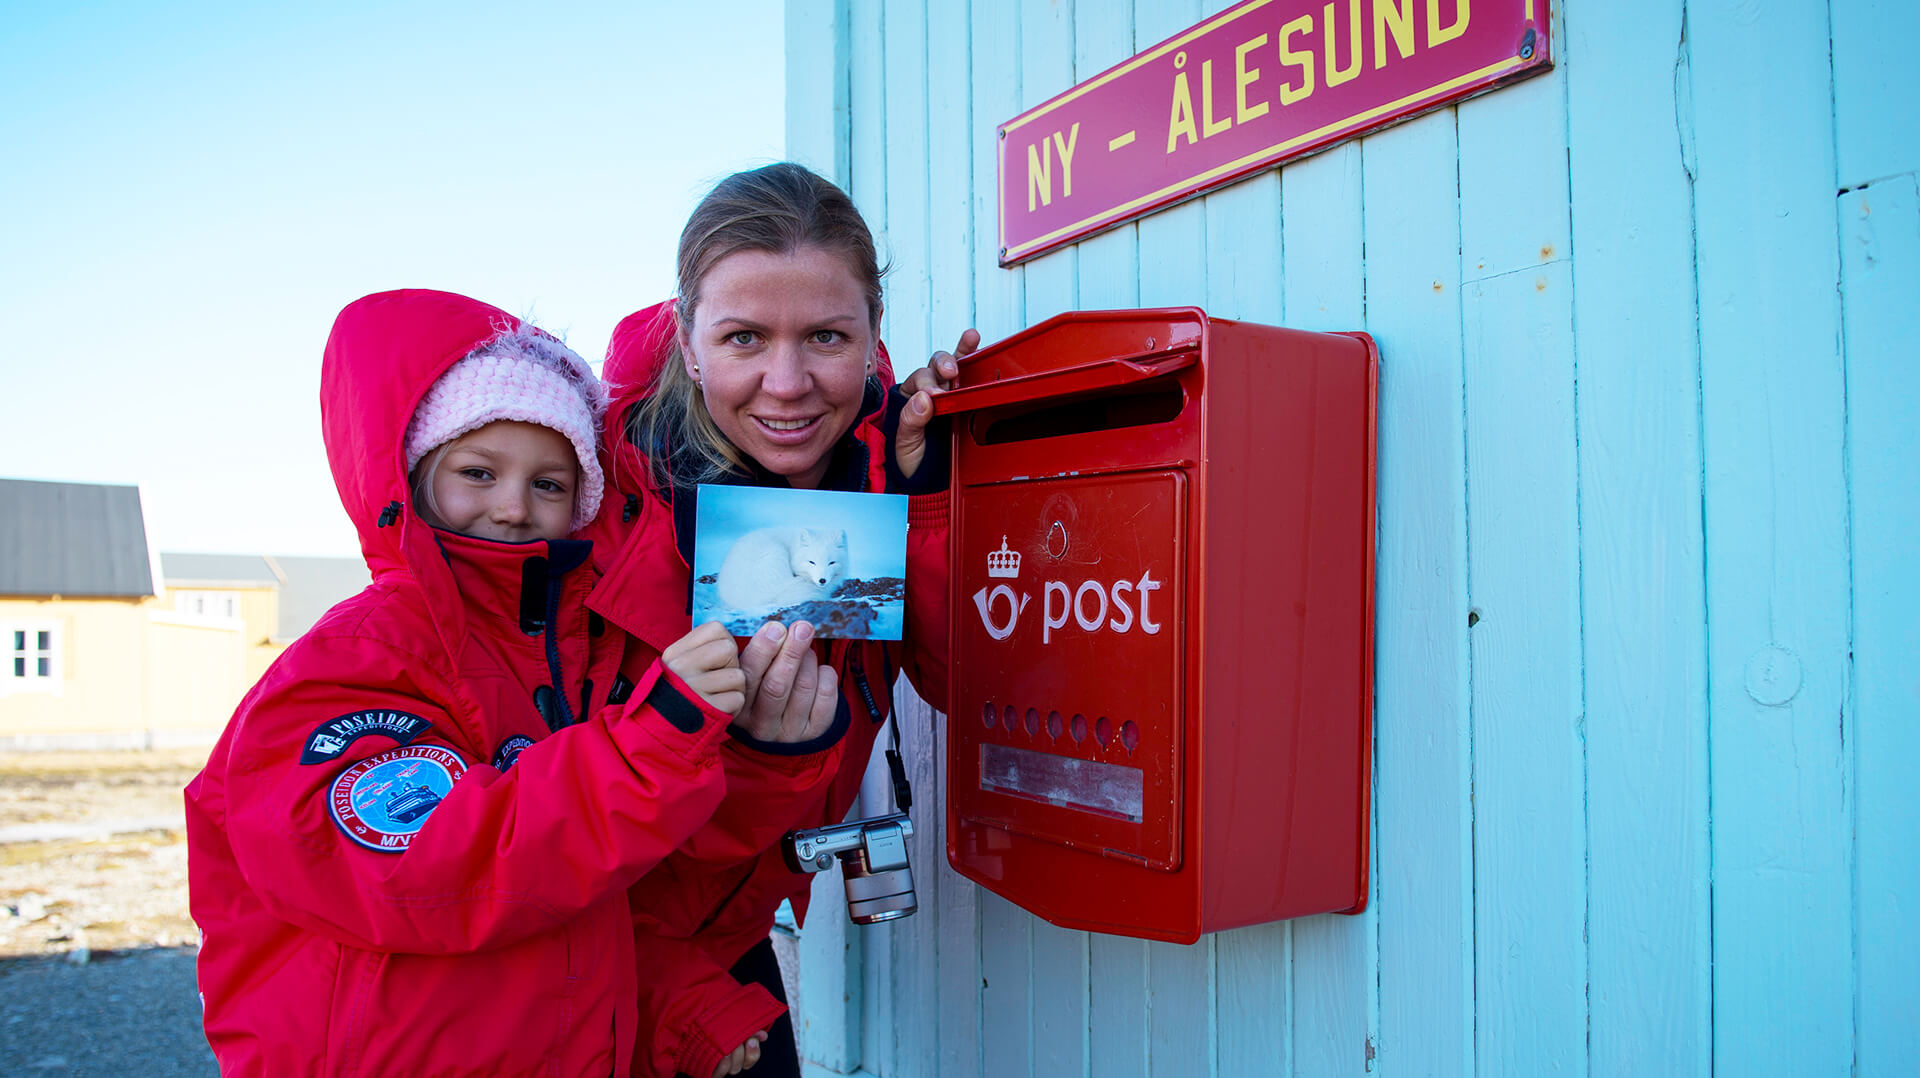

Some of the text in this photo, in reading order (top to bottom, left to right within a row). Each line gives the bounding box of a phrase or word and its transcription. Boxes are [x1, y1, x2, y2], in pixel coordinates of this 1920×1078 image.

[1028, 123, 1080, 212] NY
[1167, 0, 1471, 154] ÅLESUND
[1043, 570, 1162, 645] post
[329, 712, 418, 734] POSEIDON
[348, 724, 404, 736] EXPEDITIONS
[335, 769, 362, 821] POSEIDON
[362, 747, 455, 769] EXPEDITIONS
[380, 834, 411, 846] M/V
